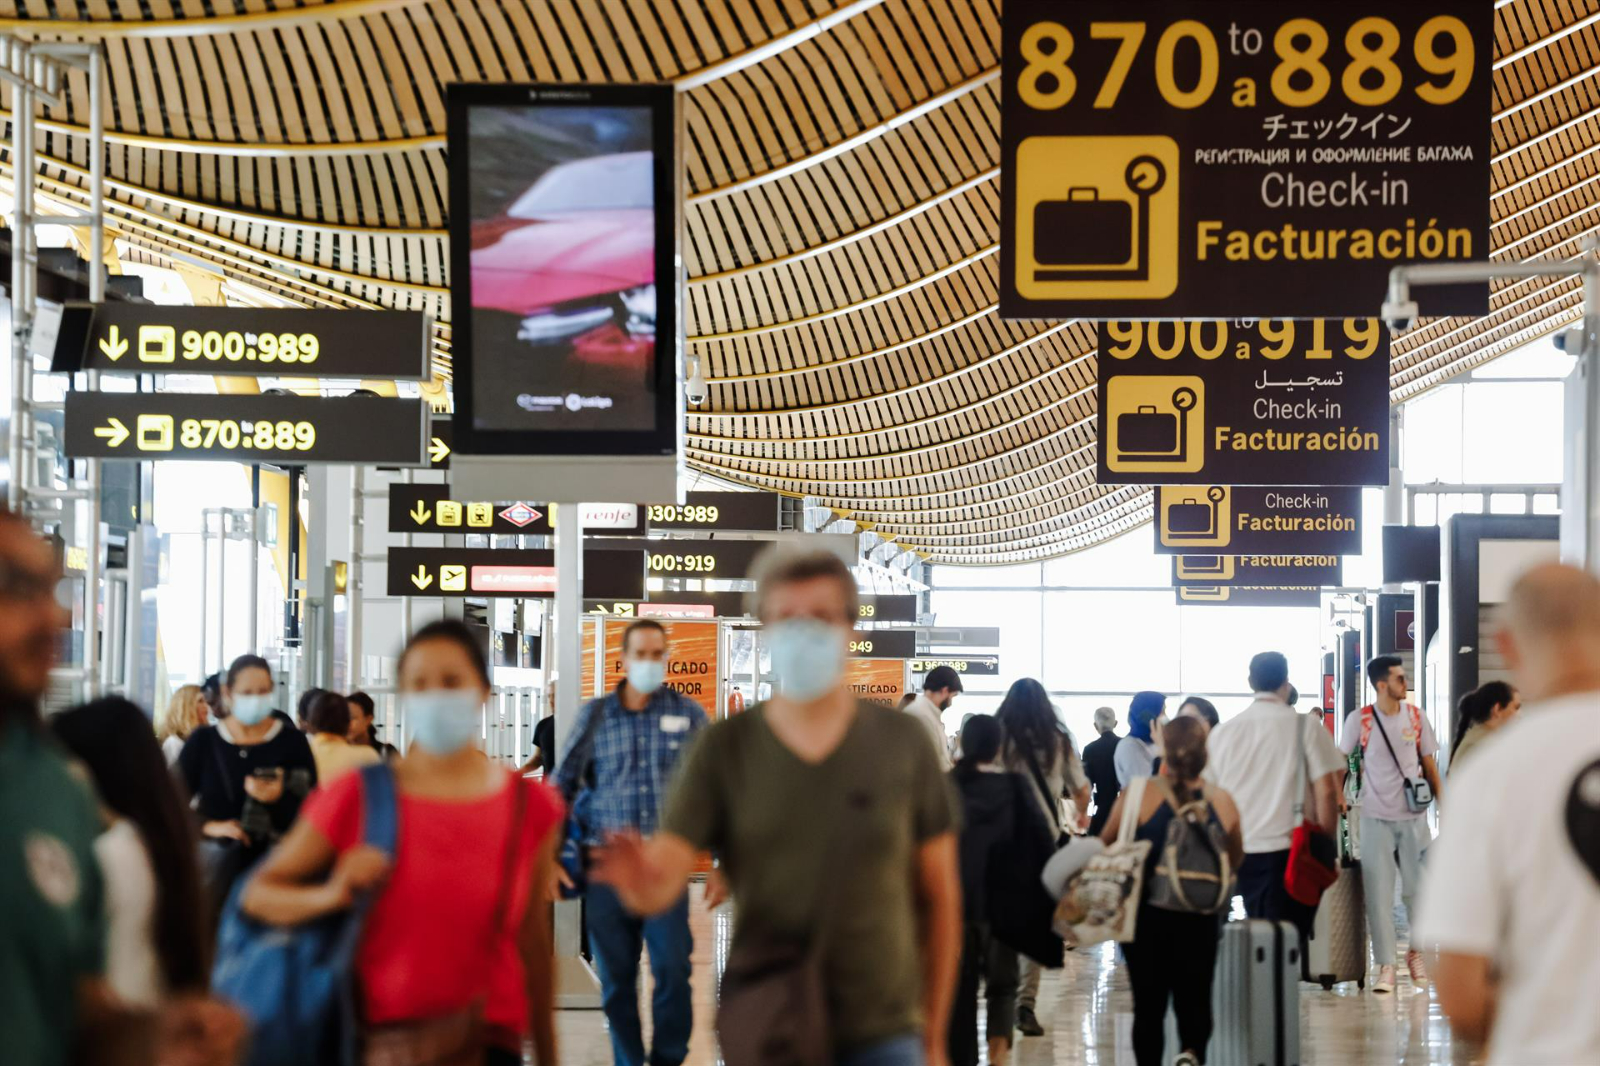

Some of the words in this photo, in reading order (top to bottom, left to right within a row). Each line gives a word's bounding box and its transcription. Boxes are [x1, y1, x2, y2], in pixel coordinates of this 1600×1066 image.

[1228, 22, 1262, 55] to
[1017, 20, 1219, 110] 870
[1270, 15, 1475, 108] 889
[1231, 77, 1257, 108] a
[1262, 112, 1411, 141] チェックイン
[1195, 148, 1290, 165] РЕГИСТРАЦИЯ
[1296, 148, 1306, 163] И
[1312, 147, 1411, 163] ОФОРМЛЕНИЕ
[1417, 146, 1474, 161] БАГАЖА
[1261, 171, 1408, 207] Check-in
[1197, 218, 1473, 261] Facturación
[181, 330, 245, 361] 900
[257, 332, 320, 364] 989
[1106, 319, 1228, 360] 900
[1235, 341, 1251, 360] a
[1258, 318, 1380, 360] 919
[1255, 369, 1343, 391] تسجيل
[1253, 398, 1341, 419] Check-in
[180, 418, 241, 449] 870
[253, 420, 316, 451] 889
[1215, 426, 1379, 451] Facturación
[683, 505, 719, 522] 989
[1265, 493, 1328, 509] Check-in
[1238, 513, 1356, 531] Facturación
[684, 555, 715, 572] 919
[859, 605, 875, 616] 89
[849, 641, 873, 653] 949
